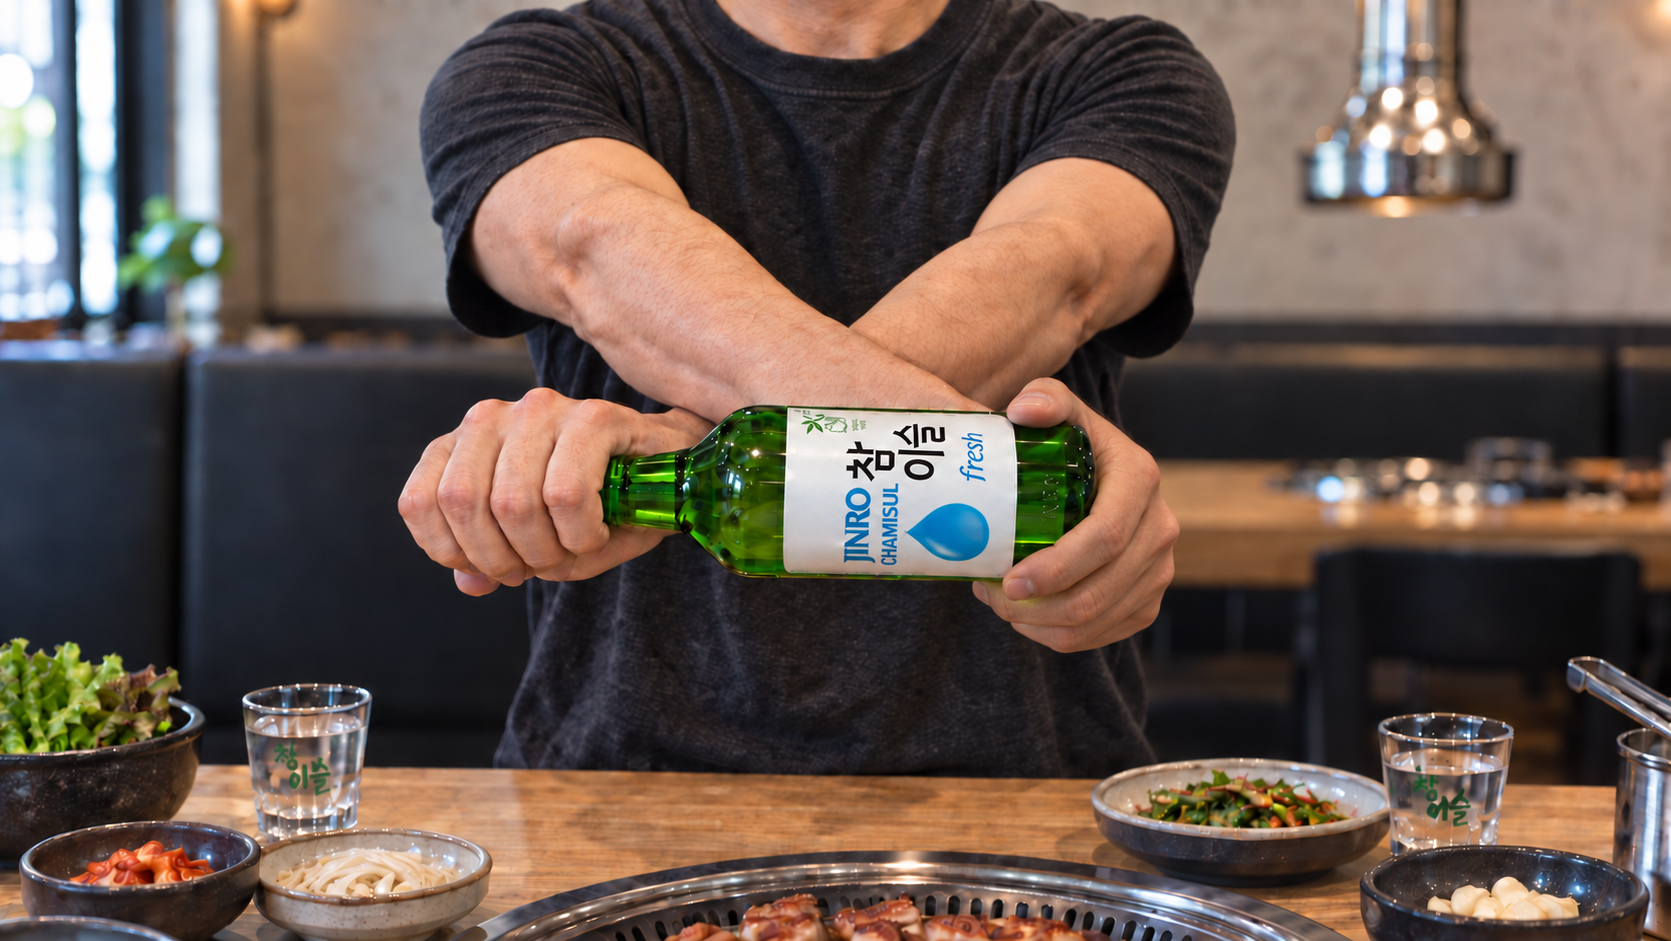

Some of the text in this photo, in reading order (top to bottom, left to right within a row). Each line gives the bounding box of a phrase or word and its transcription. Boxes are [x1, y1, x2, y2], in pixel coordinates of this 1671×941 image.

[846, 441, 896, 482] 참
[893, 423, 946, 481] 이슬
[959, 432, 987, 482] fresh
[844, 487, 875, 563] JINRO
[881, 483, 899, 566] CHAMISUL
